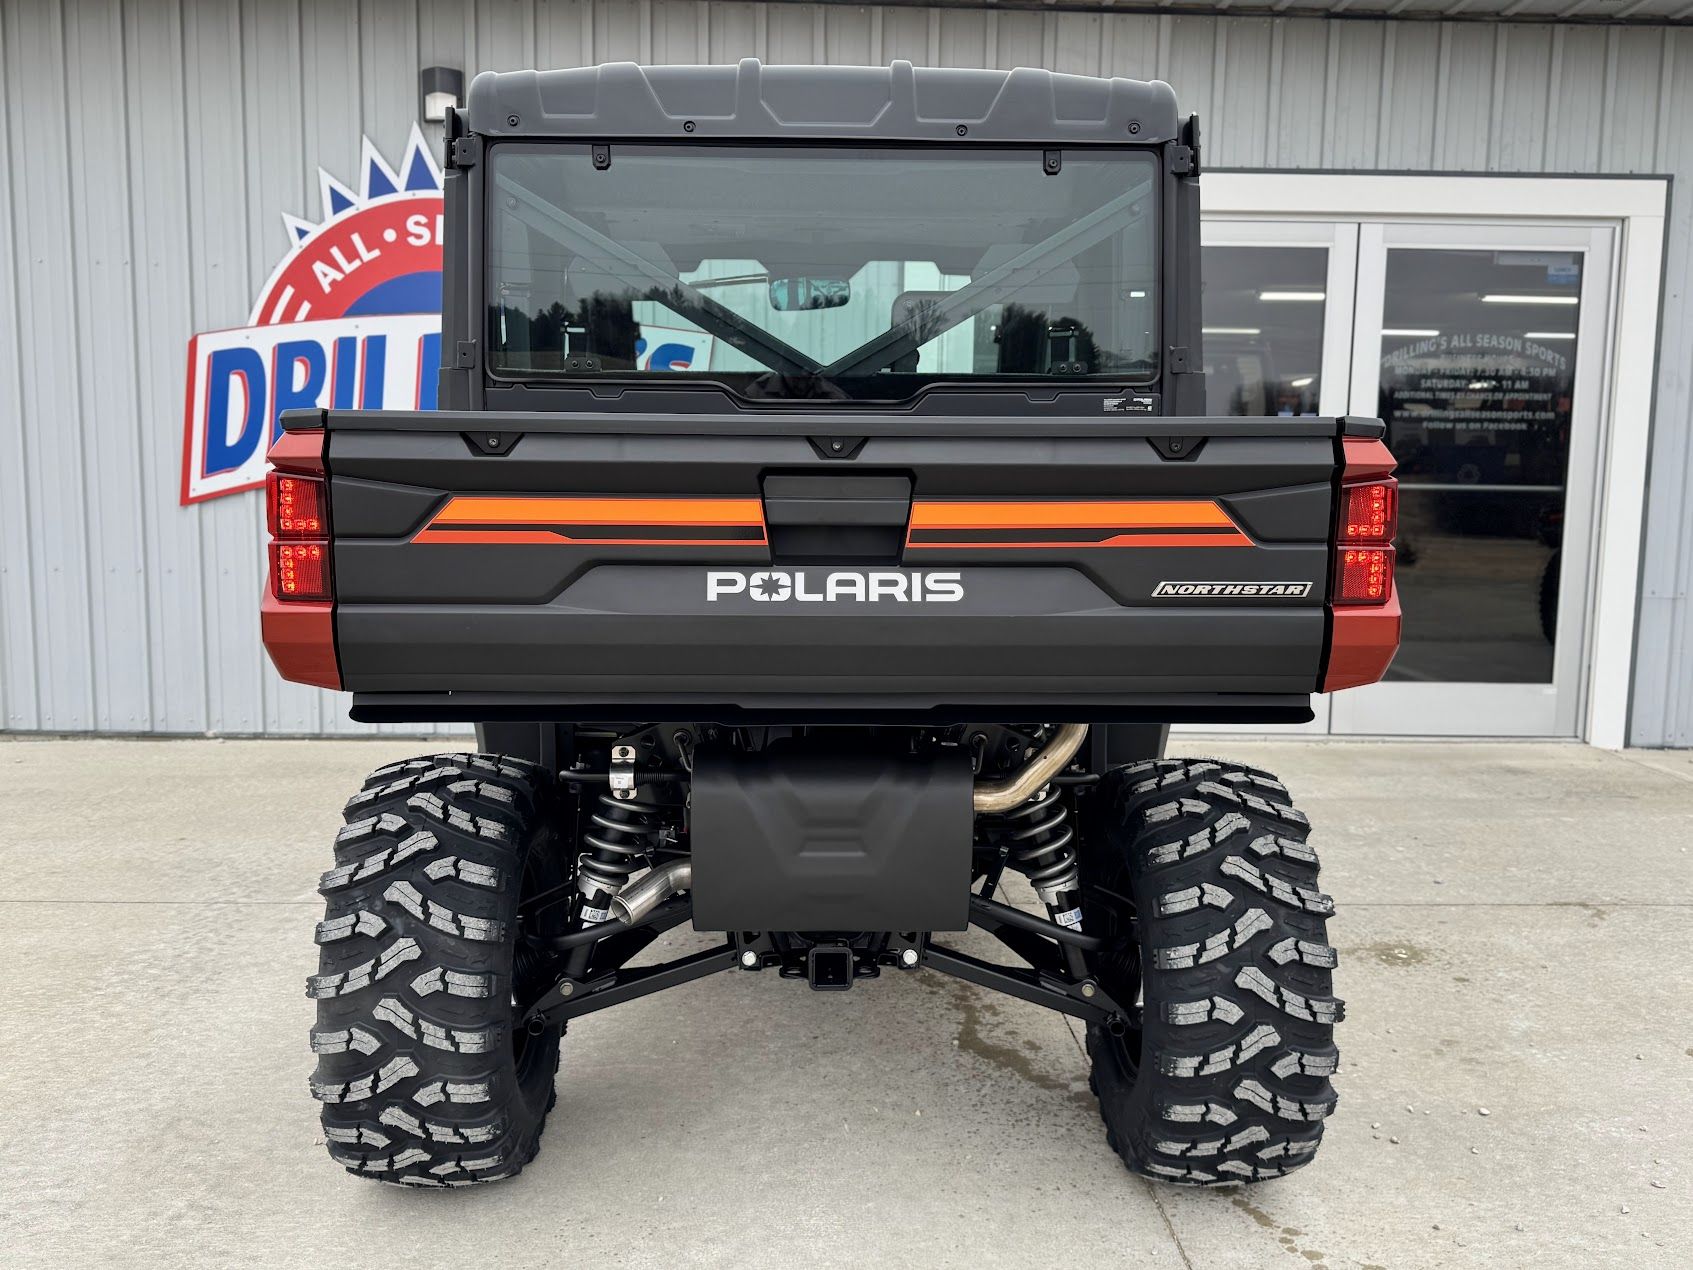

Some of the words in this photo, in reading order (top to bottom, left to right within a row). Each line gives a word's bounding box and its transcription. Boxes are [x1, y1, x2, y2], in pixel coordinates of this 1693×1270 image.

[312, 232, 381, 294] ALL
[1450, 334, 1473, 348] ALL
[1476, 334, 1522, 352] SEASON
[1525, 341, 1567, 370] SPORTS
[1542, 368, 1557, 377] PM
[1514, 380, 1529, 389] AM
[707, 571, 964, 602] POLARIS
[1161, 584, 1304, 595] NORTHSTAR
